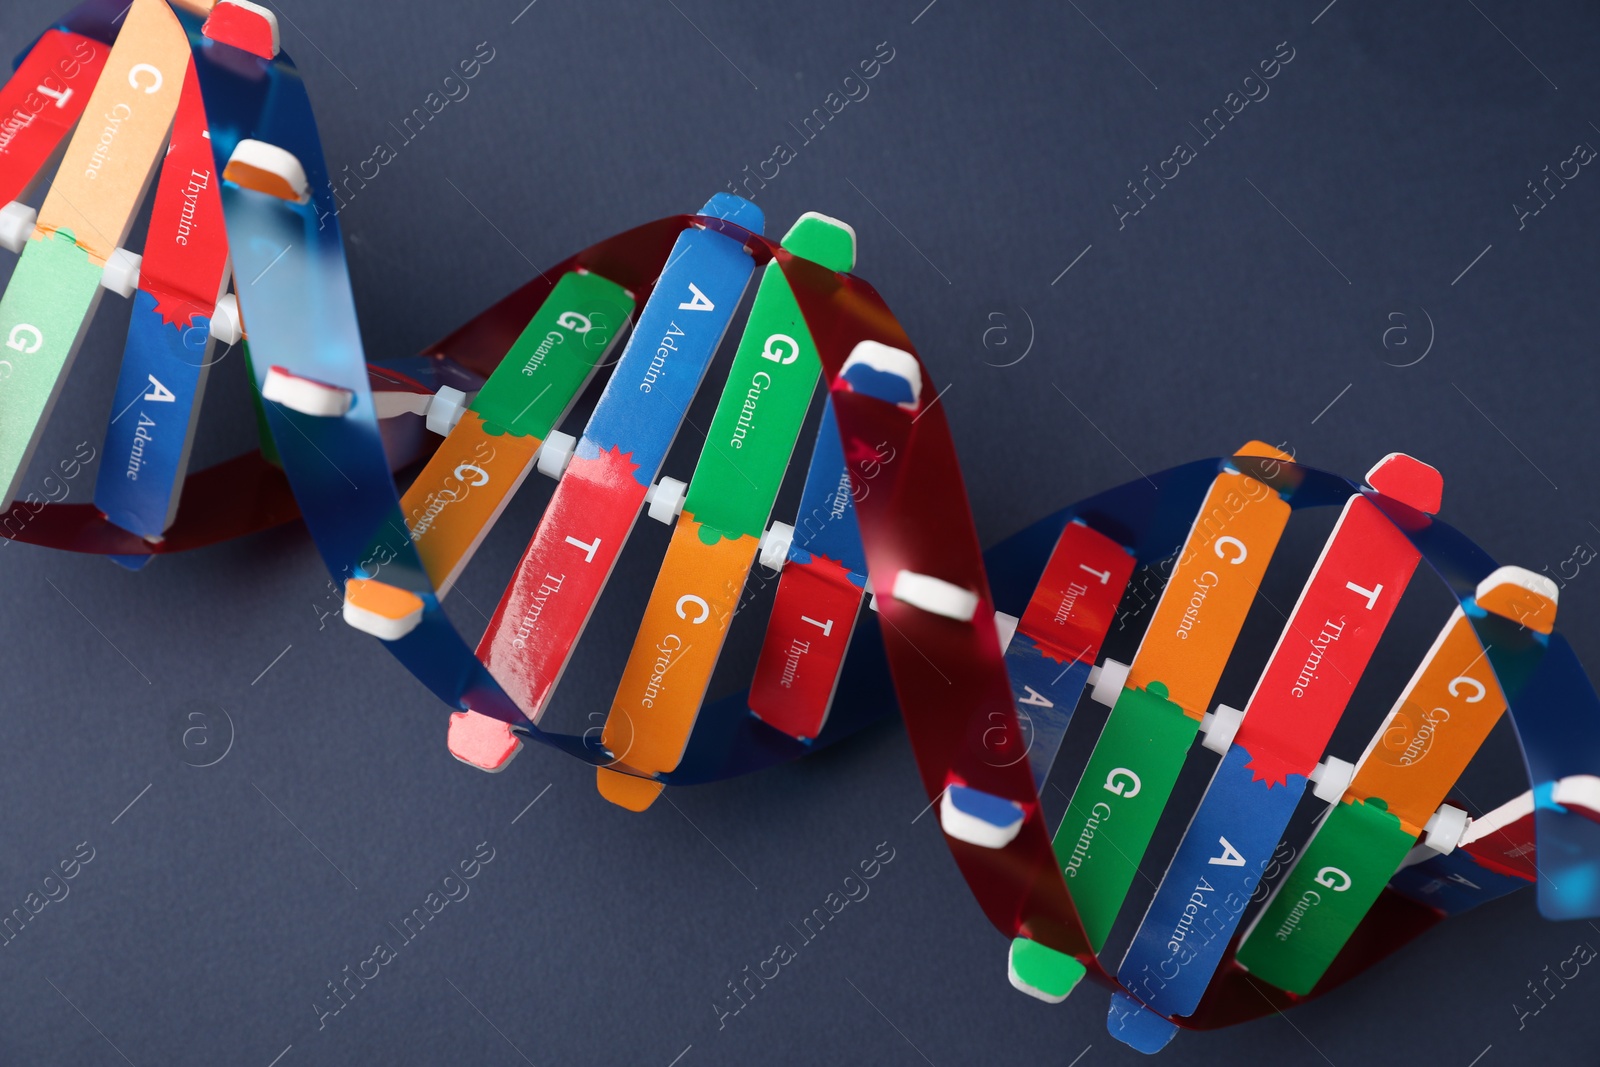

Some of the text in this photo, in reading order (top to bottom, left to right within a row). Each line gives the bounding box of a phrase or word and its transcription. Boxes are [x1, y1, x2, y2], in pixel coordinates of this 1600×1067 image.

[36, 84, 73, 108] T
[85, 63, 163, 180] C Cytosine
[175, 168, 211, 246] Thymine
[5, 323, 44, 354] G
[521, 311, 593, 377] G Guanine
[639, 282, 715, 394] A Adenine
[126, 373, 176, 481] A Adenine
[730, 333, 800, 449] G Guanine
[453, 463, 490, 487] C
[512, 535, 602, 650] T Thymine
[1053, 563, 1111, 625] T Thymine
[1176, 535, 1248, 640] C Cytosine
[641, 594, 710, 709] C Cytosine
[780, 615, 834, 688] T Thymine
[1291, 581, 1384, 698] T Thymine
[1018, 685, 1054, 708] A
[1399, 675, 1487, 766] C Cytosine
[1064, 767, 1142, 878] G Guanine
[1167, 835, 1247, 953] A Adenine
[1276, 866, 1352, 941] G Guanine
